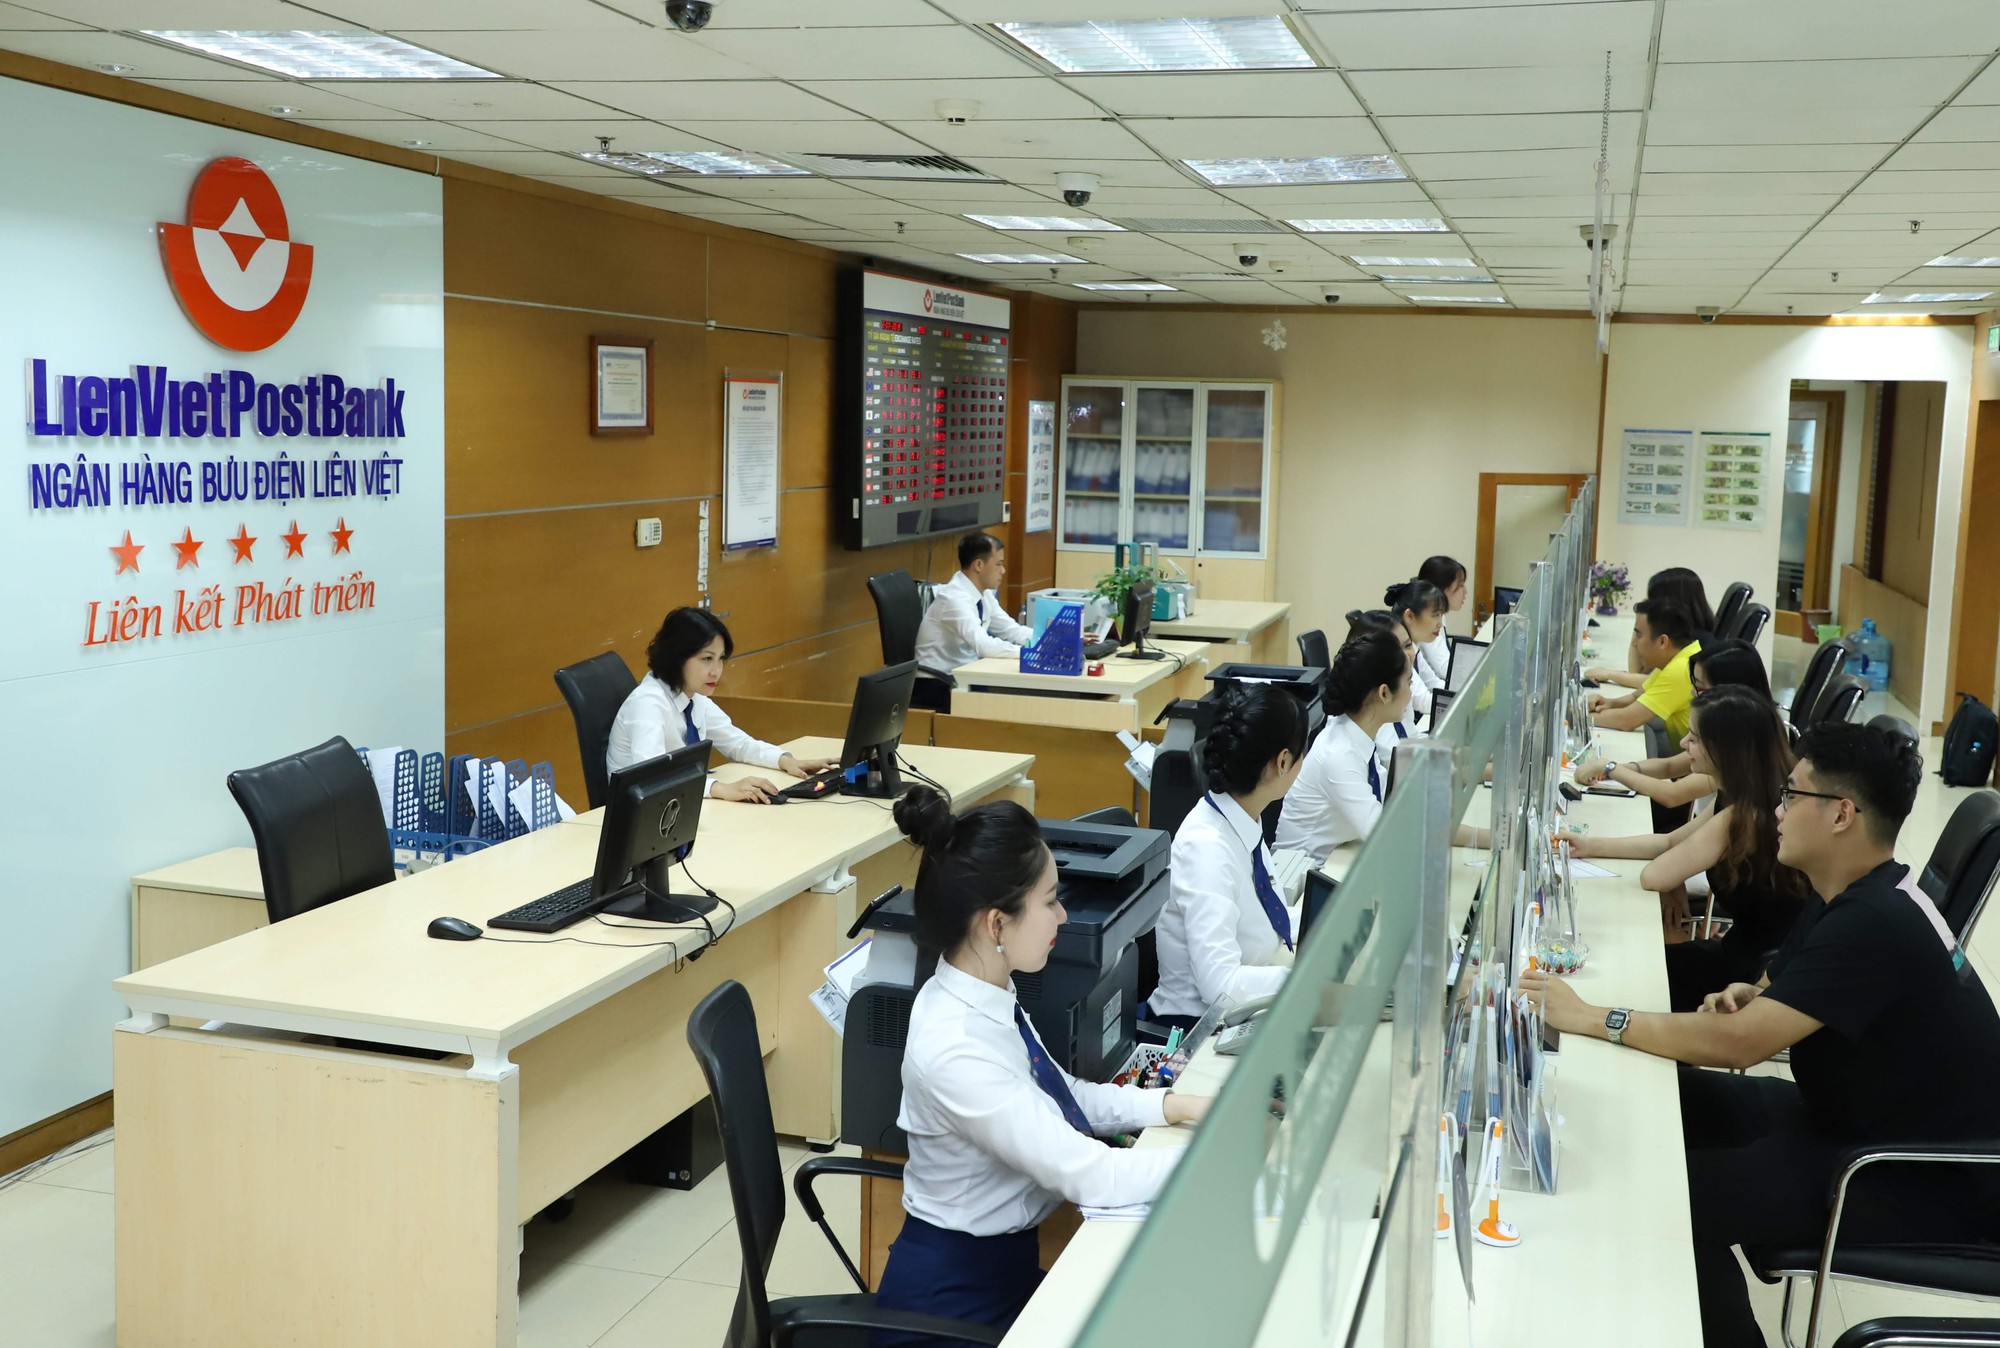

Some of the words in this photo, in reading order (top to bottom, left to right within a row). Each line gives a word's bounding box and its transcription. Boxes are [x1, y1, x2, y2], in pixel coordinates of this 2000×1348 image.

[29, 358, 406, 438] LienVietPostBank
[31, 453, 111, 509] NGÂN
[121, 453, 193, 506] HÀNG
[202, 455, 249, 503] BƯU
[254, 451, 305, 506] ĐIỆN
[313, 451, 357, 498] LIÊN
[363, 451, 403, 501] VIỆT
[83, 596, 162, 647] Liên
[175, 585, 226, 634] kết
[235, 577, 304, 626] Phát
[313, 570, 376, 615] triển
